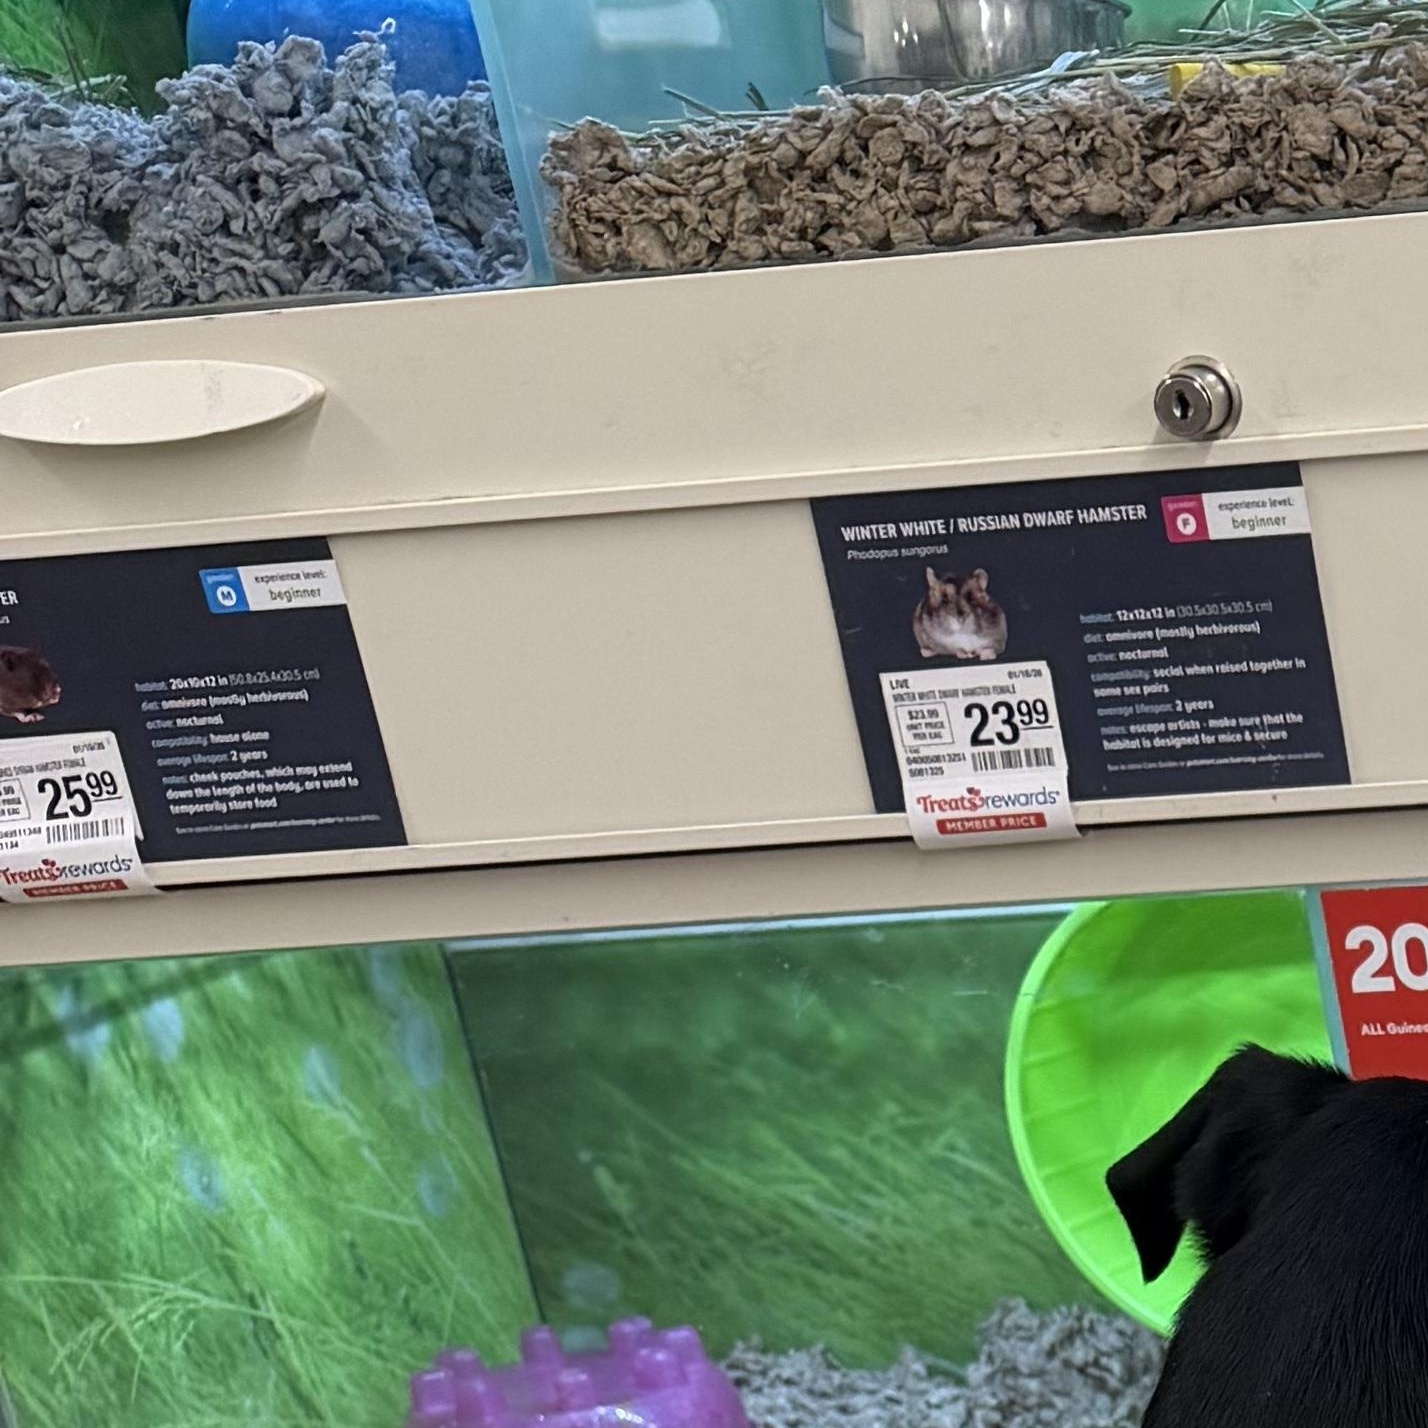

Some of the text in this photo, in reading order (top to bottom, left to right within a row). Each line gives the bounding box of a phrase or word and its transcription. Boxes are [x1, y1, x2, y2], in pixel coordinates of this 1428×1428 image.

[1218, 501, 1267, 512] experience
[841, 522, 897, 542] WINTER
[899, 519, 947, 537] WHITE
[950, 519, 954, 534] /
[957, 513, 1021, 533] RUSSIAN
[1023, 510, 1074, 529] DWARF
[1077, 504, 1147, 524] HAMSTER
[1182, 518, 1190, 529] F
[1232, 515, 1286, 531] beginner
[847, 544, 948, 561] Phodopus sungorus
[255, 572, 301, 584] experience
[0, 590, 19, 605] ER
[221, 591, 233, 601] M
[269, 587, 321, 602] beginner
[1117, 606, 1176, 622] 12x12x12 in
[1106, 620, 1261, 642] omnivore (mostly herbivorous)
[1119, 647, 1169, 661] nocturnal
[1154, 658, 1306, 678] social when raised together in
[889, 678, 910, 690] LIVE
[1123, 683, 1169, 696] sex pairs
[1175, 699, 1214, 714] 2 years
[176, 714, 223, 727] nocturnal
[1130, 711, 1303, 736] escape artists make sure that the
[1103, 730, 1288, 751] habitat is designed for mice secure
[230, 750, 268, 763] 2 years
[319, 762, 352, 774] extend
[194, 777, 358, 799] the length of the to
[255, 797, 277, 809] food
[917, 786, 1057, 813] Treats rewards
[945, 815, 1037, 831] MEMBER PRICE
[60, 854, 132, 878] rewards
[1361, 1023, 1386, 1036] ALL
